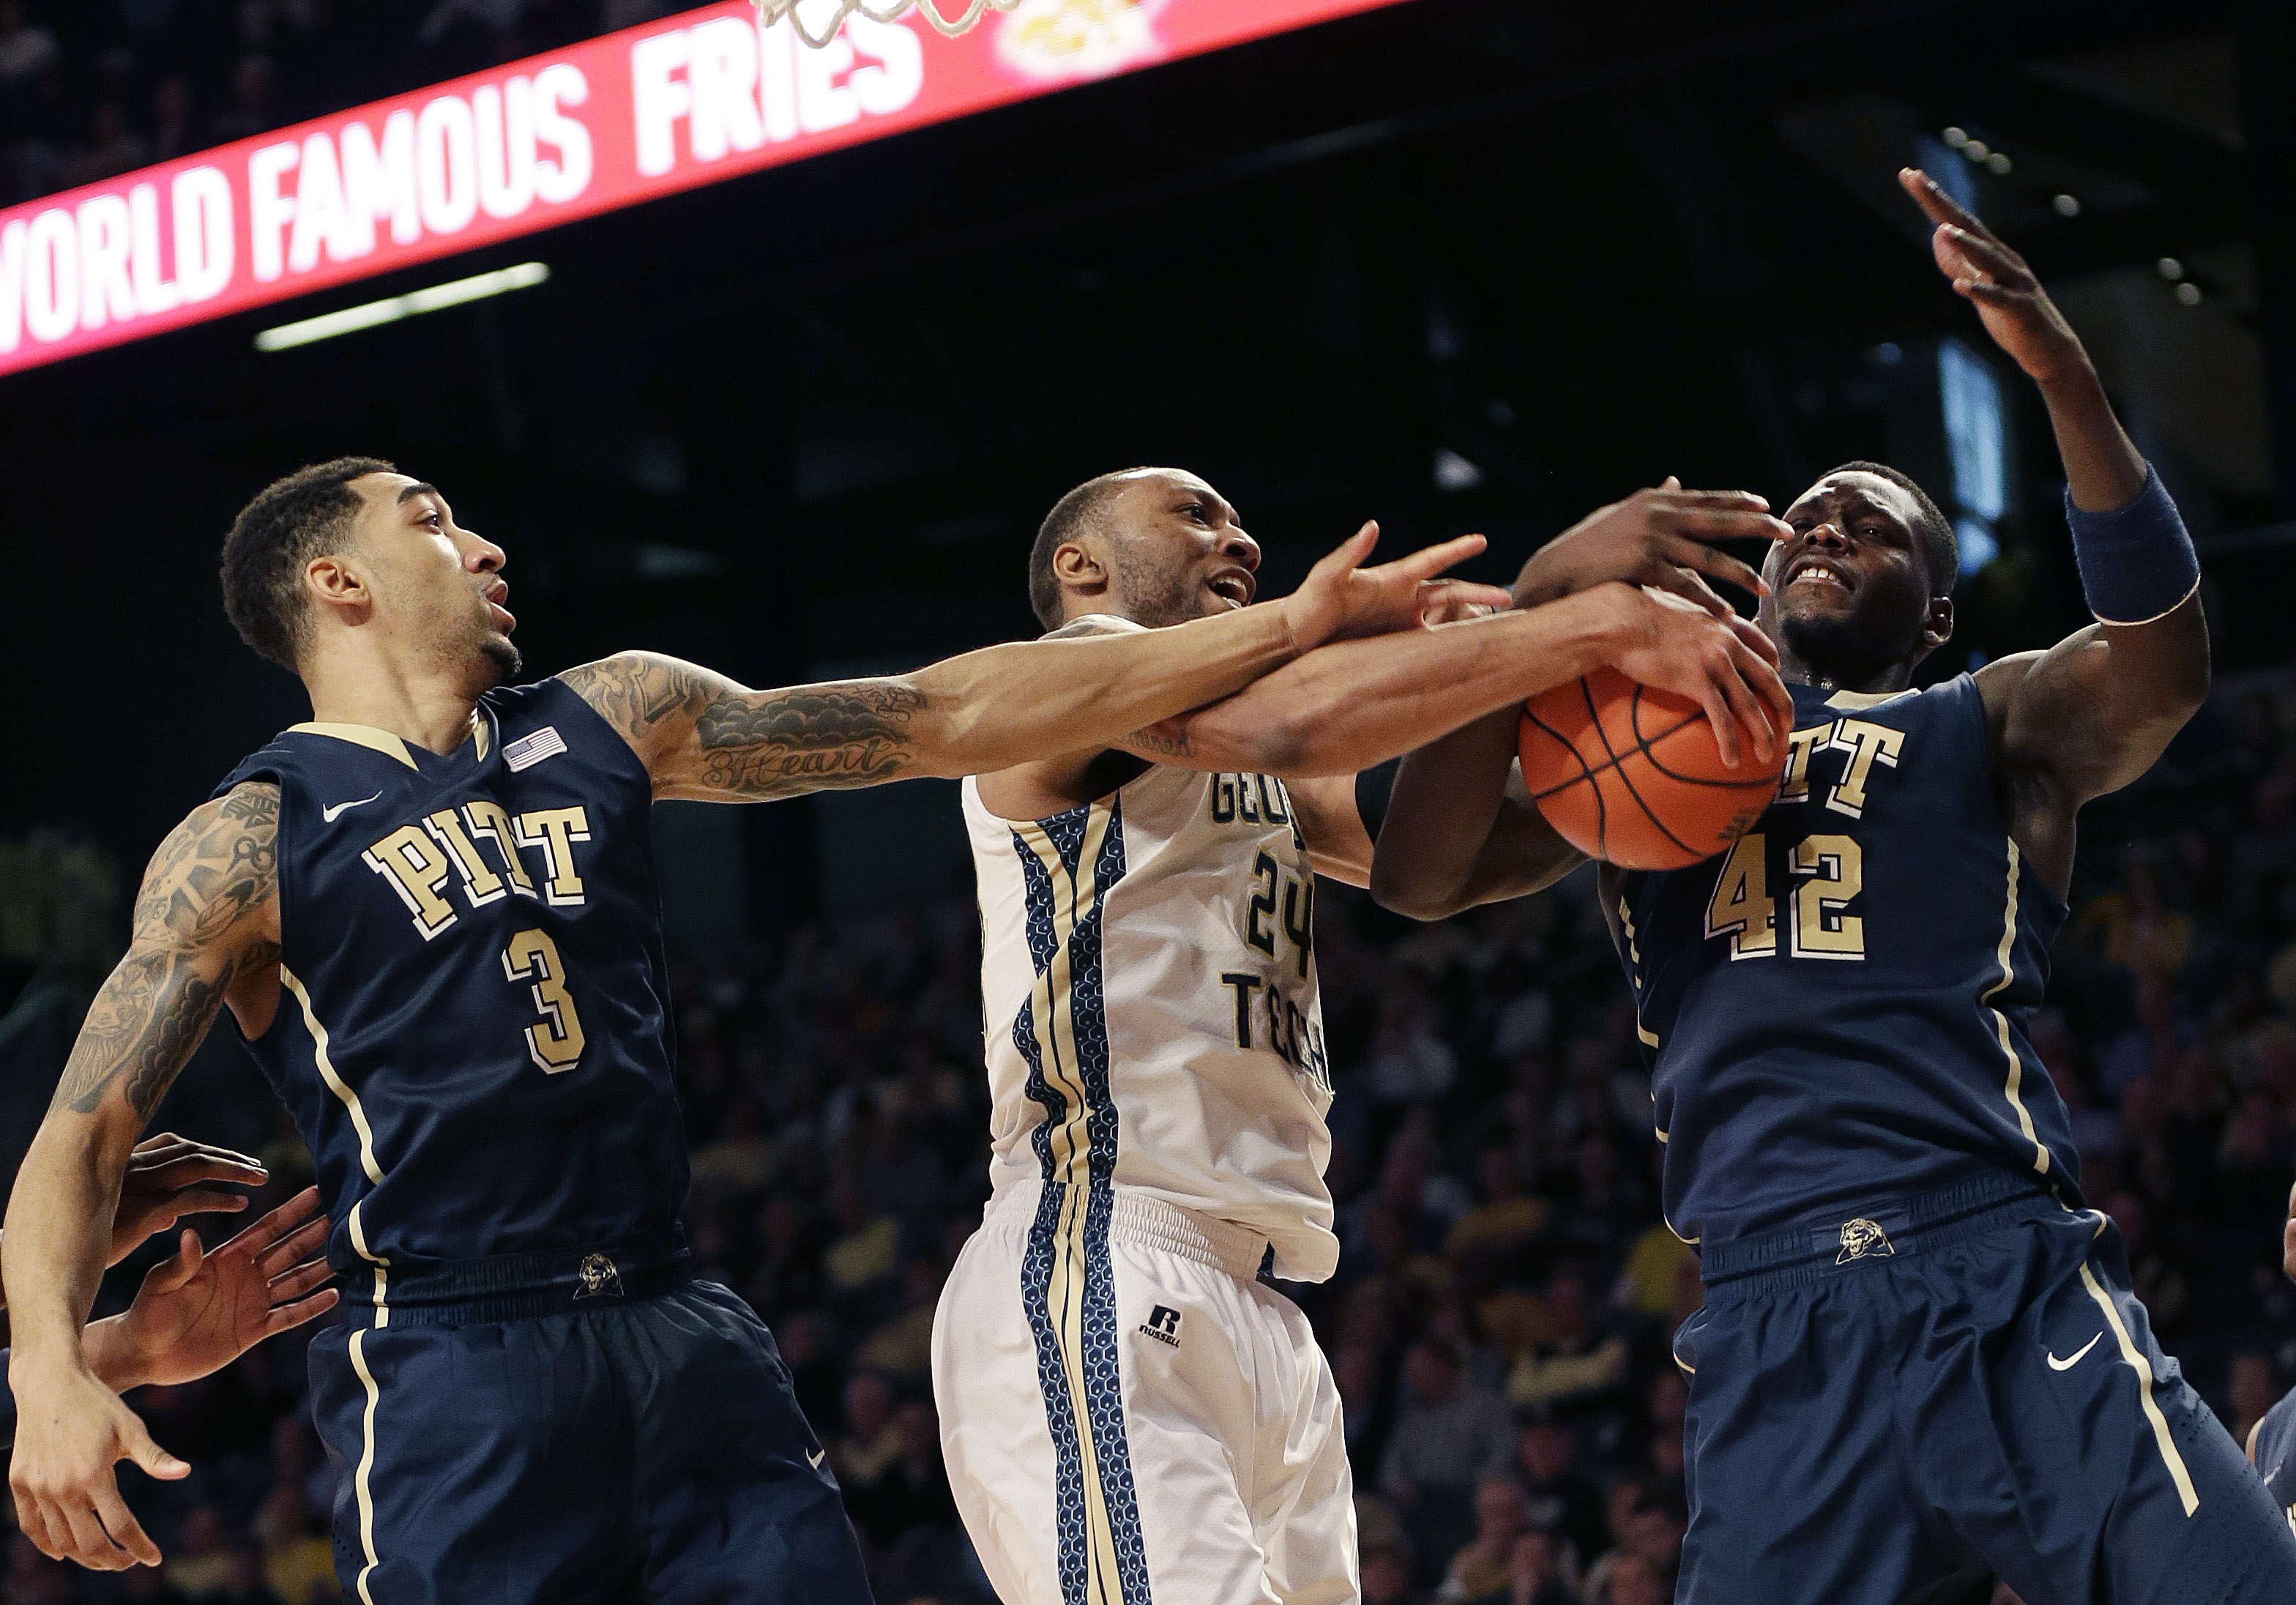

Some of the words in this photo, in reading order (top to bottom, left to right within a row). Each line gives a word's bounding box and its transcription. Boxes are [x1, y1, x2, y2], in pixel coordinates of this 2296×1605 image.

[248, 63, 592, 283] FAMOUS
[631, 6, 923, 177] FRIES
[1772, 718, 1906, 819] TT
[362, 801, 590, 942] PITT
[1245, 842, 1314, 978] 24
[1704, 832, 1865, 961] 42
[502, 928, 585, 1074] 3
[1138, 1324, 1181, 1349] RUSSELL
